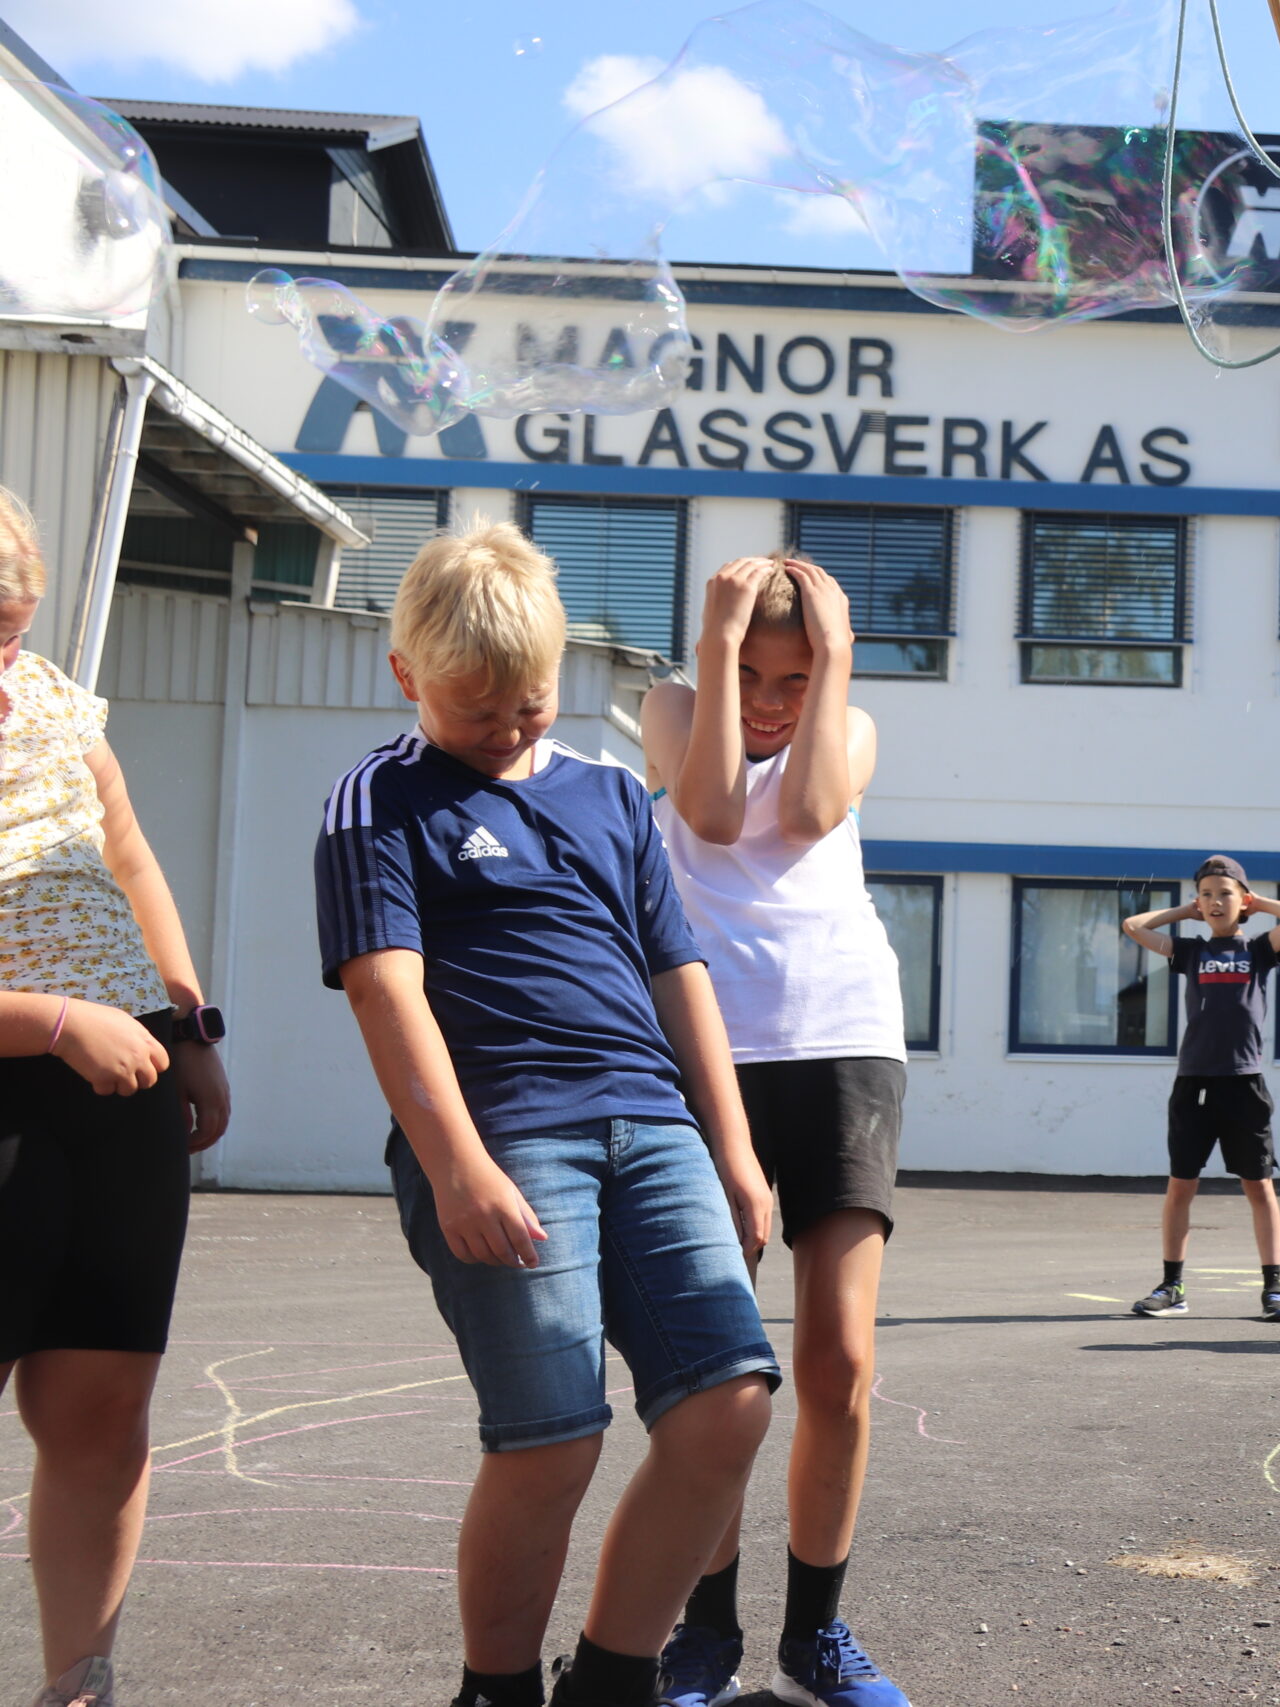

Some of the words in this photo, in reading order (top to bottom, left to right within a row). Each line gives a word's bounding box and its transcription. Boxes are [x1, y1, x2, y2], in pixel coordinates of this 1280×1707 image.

[516, 321, 894, 398] MAGNOR
[515, 408, 1052, 483] GLASSVERK
[1080, 425, 1192, 487] AS
[458, 846, 509, 861] adidas
